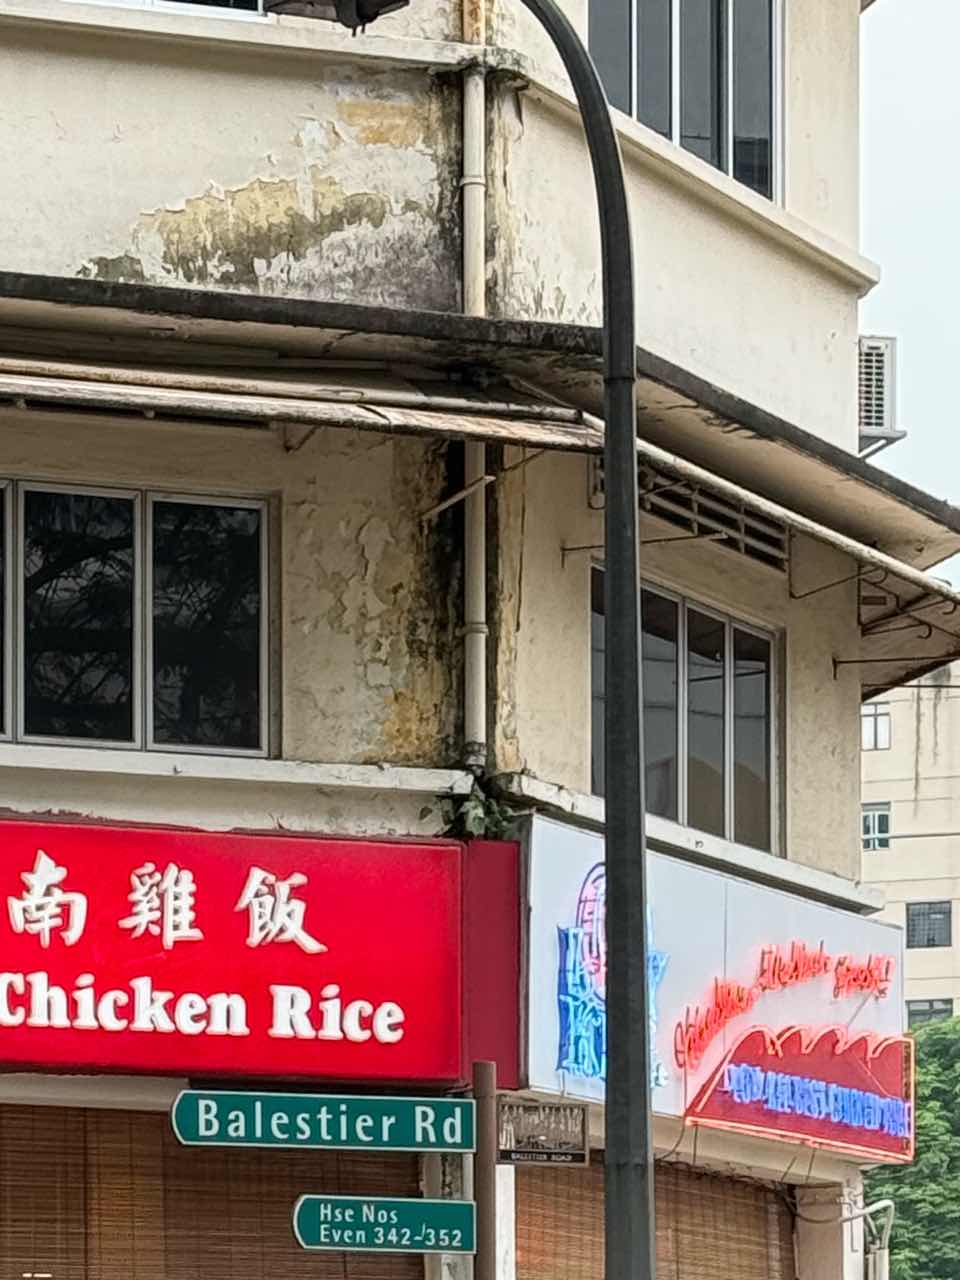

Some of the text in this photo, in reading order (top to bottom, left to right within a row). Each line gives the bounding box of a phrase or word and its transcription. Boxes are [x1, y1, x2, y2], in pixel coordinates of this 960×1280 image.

[268, 984, 405, 1044] Rice
[197, 1099, 462, 1143] Balestier Rd
[319, 1203, 398, 1224] Hse Nos
[319, 1224, 366, 1243] Even
